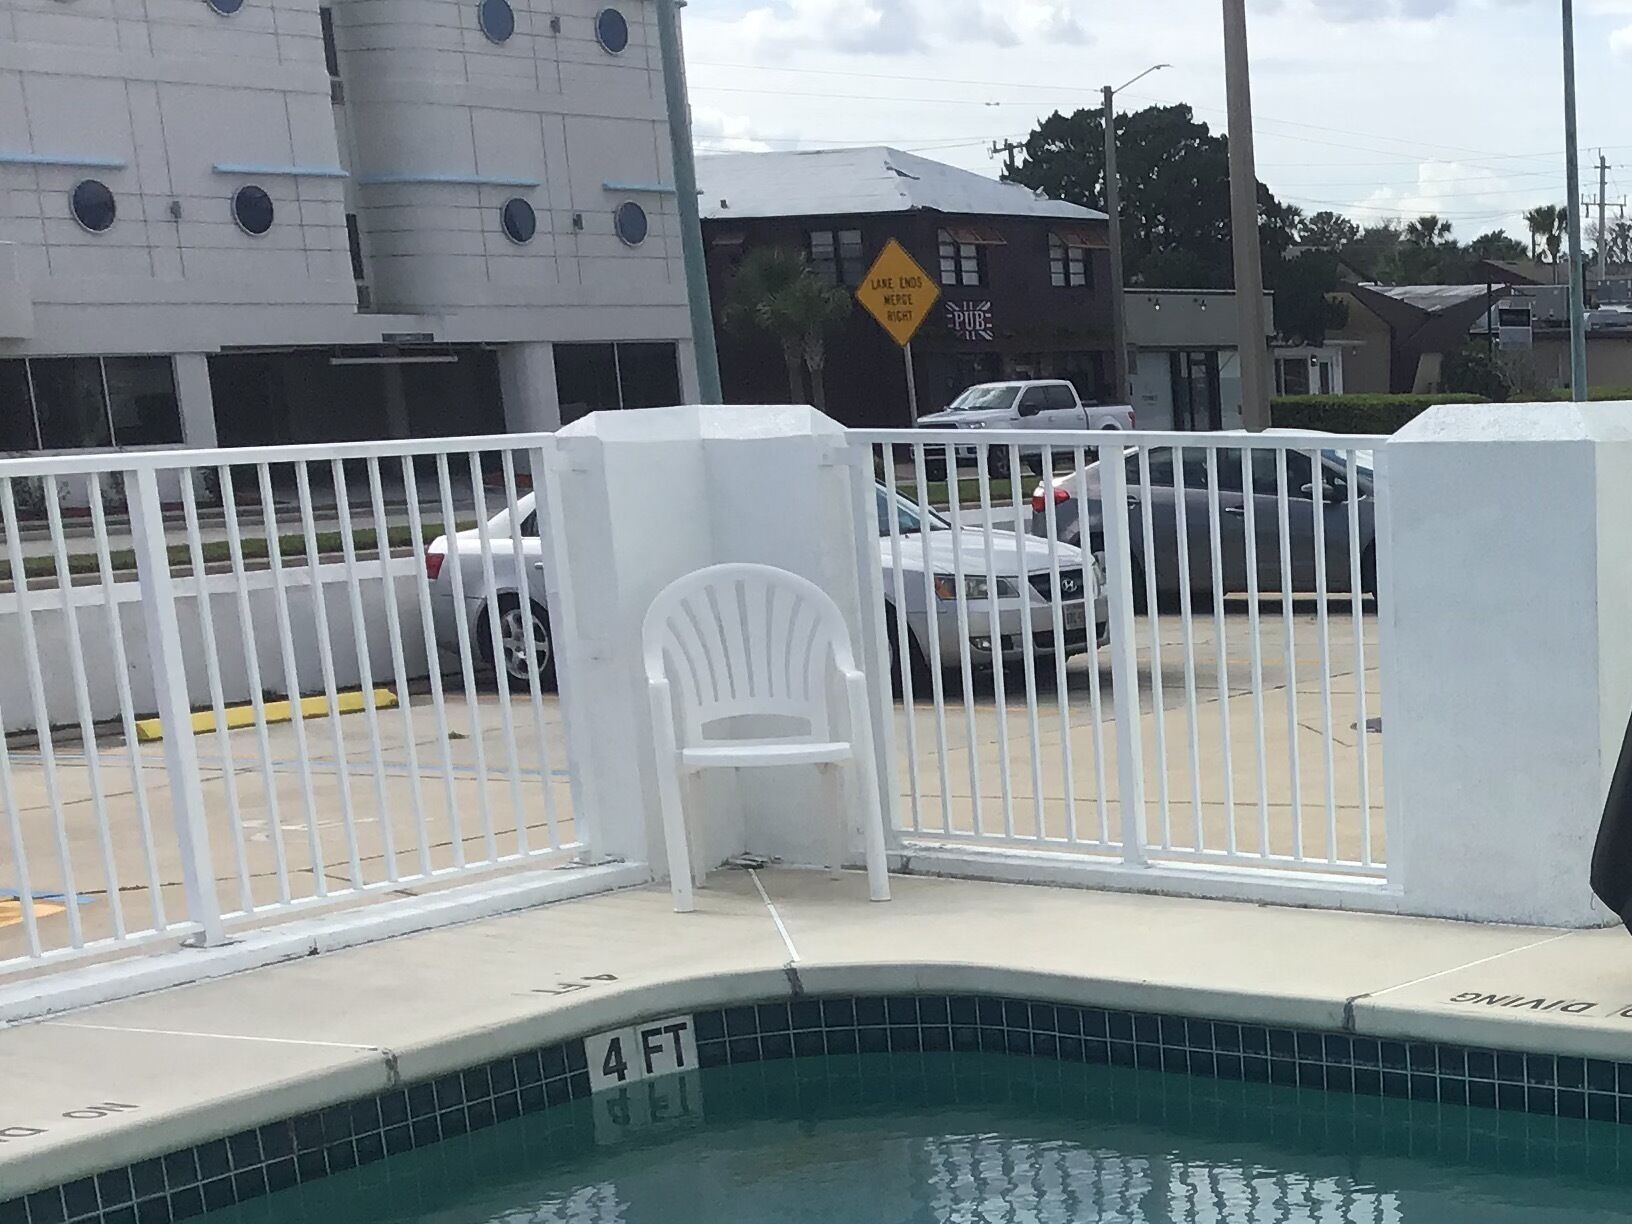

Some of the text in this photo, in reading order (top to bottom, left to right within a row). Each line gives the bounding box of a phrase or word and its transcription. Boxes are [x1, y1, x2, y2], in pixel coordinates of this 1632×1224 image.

[871, 276, 922, 290] LANE ENDS
[883, 293, 913, 305] MERGE
[887, 310, 912, 322] RIGHT
[953, 311, 985, 330] PUB
[1450, 992, 1598, 1013] DIVING
[602, 1022, 688, 1083] 4 FT
